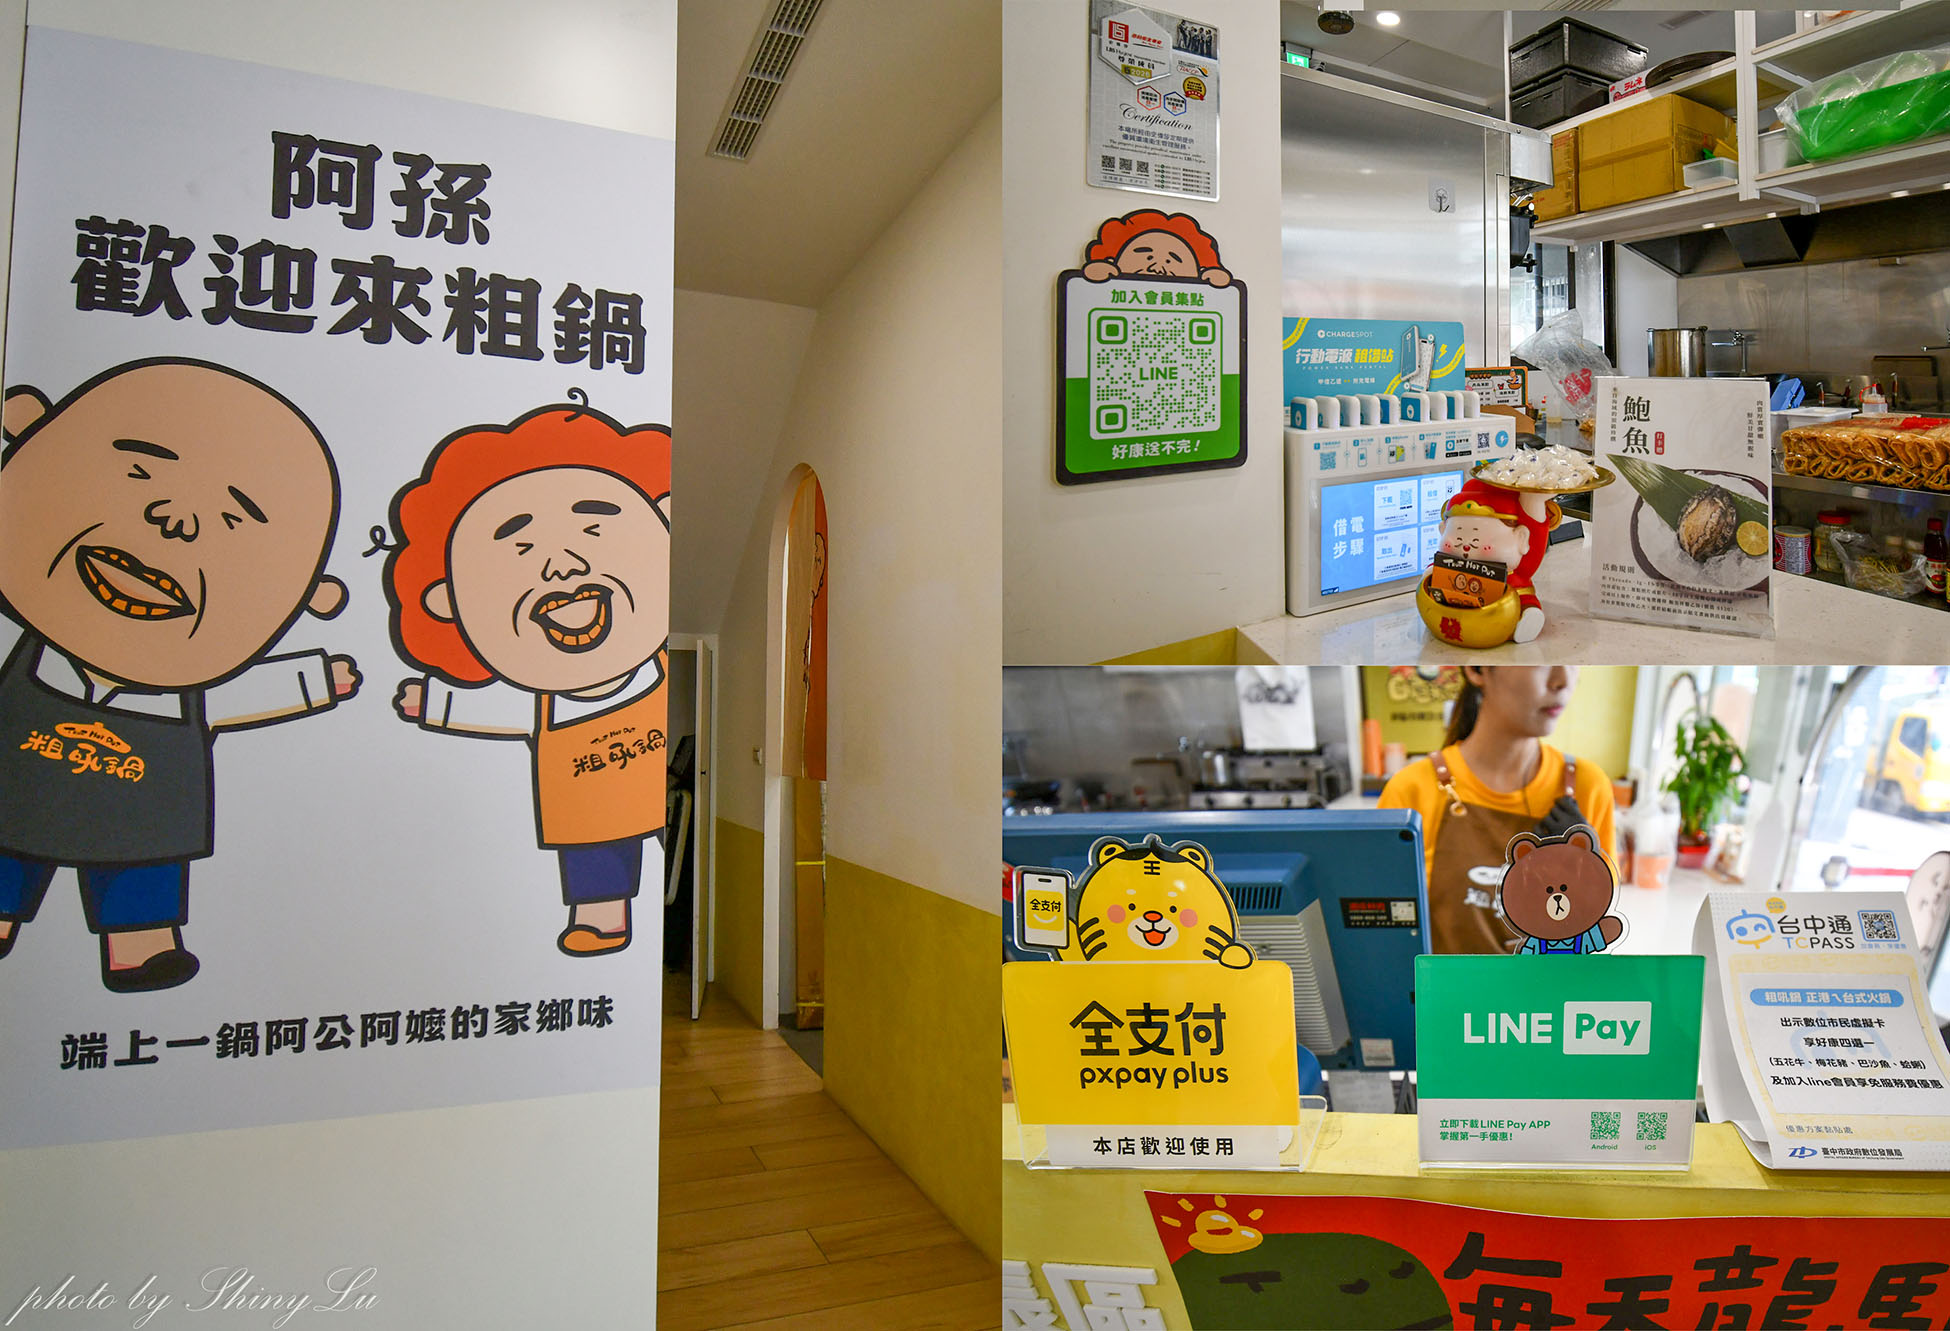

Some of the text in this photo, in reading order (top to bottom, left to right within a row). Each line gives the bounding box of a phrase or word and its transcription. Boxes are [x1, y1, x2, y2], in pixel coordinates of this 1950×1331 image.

[1120, 103, 1192, 130] Certification
[271, 130, 493, 245] 阿孫
[71, 214, 647, 375] 歡迎來粗鍋
[1111, 288, 1205, 306] 加入會員集點
[1326, 330, 1373, 338] CHARGESPOT
[1295, 348, 1394, 364] 行動電源 租借站
[1139, 366, 1179, 381] LINE
[1622, 395, 1651, 455] 鮑魚
[1112, 439, 1201, 460] 好康送不完!
[1333, 516, 1365, 537] 借電
[1333, 538, 1365, 560] 步驟
[1030, 898, 1061, 912] 全支付
[1777, 915, 1854, 935] 台中通
[1782, 936, 1855, 949] TCPASS
[1069, 1000, 1226, 1056] 全支付
[1464, 1012, 1641, 1046] LINE Pay
[1780, 1017, 1886, 1028] 出示數位市民虛擬卡
[59, 995, 614, 1071] 端上一鍋阿公阿嬤的家鄉味
[1803, 1037, 1875, 1049] 享好康四選一
[1079, 1061, 1230, 1089] pxpay plus
[1770, 1075, 1945, 1090] 及加入line會員享免服務費優惠
[1507, 1120, 1526, 1131] Pay
[1529, 1120, 1551, 1129] APP
[1093, 1136, 1234, 1156] 本店歡迎使用
[1440, 1131, 1513, 1141] 掌握第一手優惠!
[1002, 1259, 1168, 1331] 區
